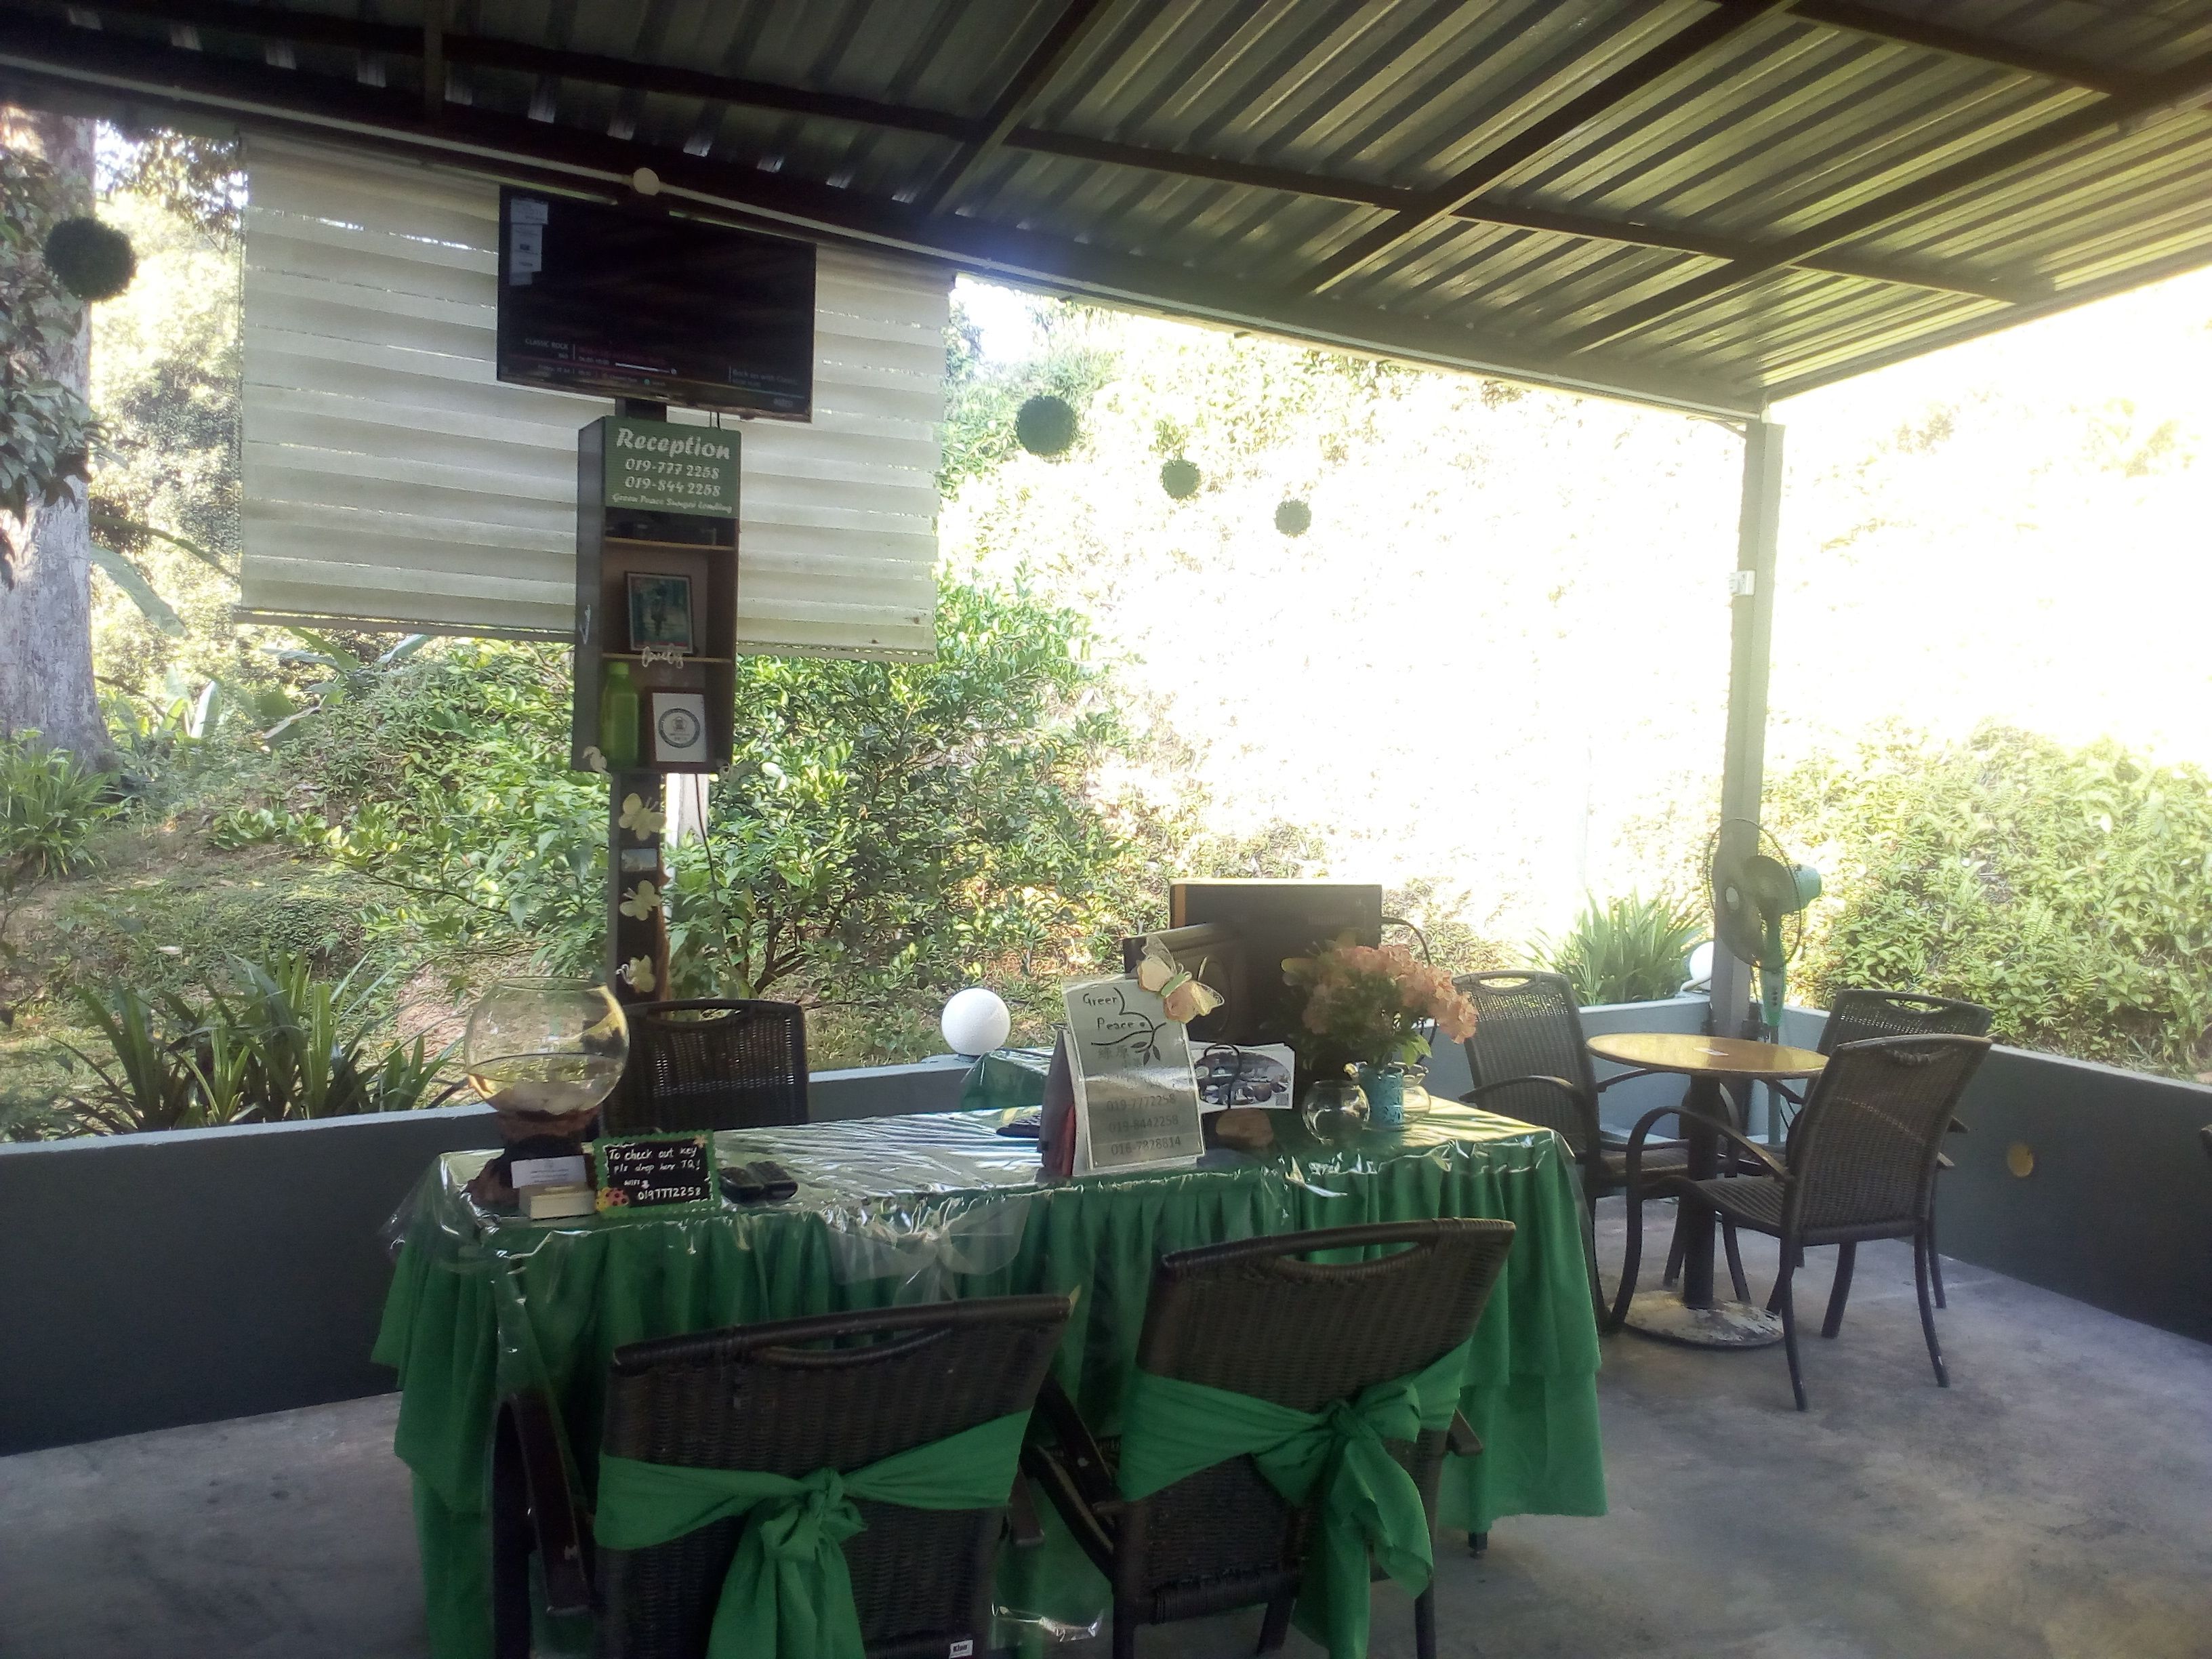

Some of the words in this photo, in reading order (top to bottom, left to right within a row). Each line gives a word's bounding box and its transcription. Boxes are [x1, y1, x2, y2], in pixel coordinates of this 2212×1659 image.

[552, 342, 569, 350] ROCK
[617, 428, 730, 459] Reception
[625, 458, 682, 475] 019-777
[686, 465, 720, 480] 2258
[625, 476, 683, 493] 019-844
[1097, 1017, 1134, 1030] Peace
[1109, 1114, 1179, 1133] 019-8442258
[609, 1149, 621, 1160] To
[625, 1149, 652, 1161] check
[658, 1147, 674, 1158] out
[680, 1147, 697, 1158] key
